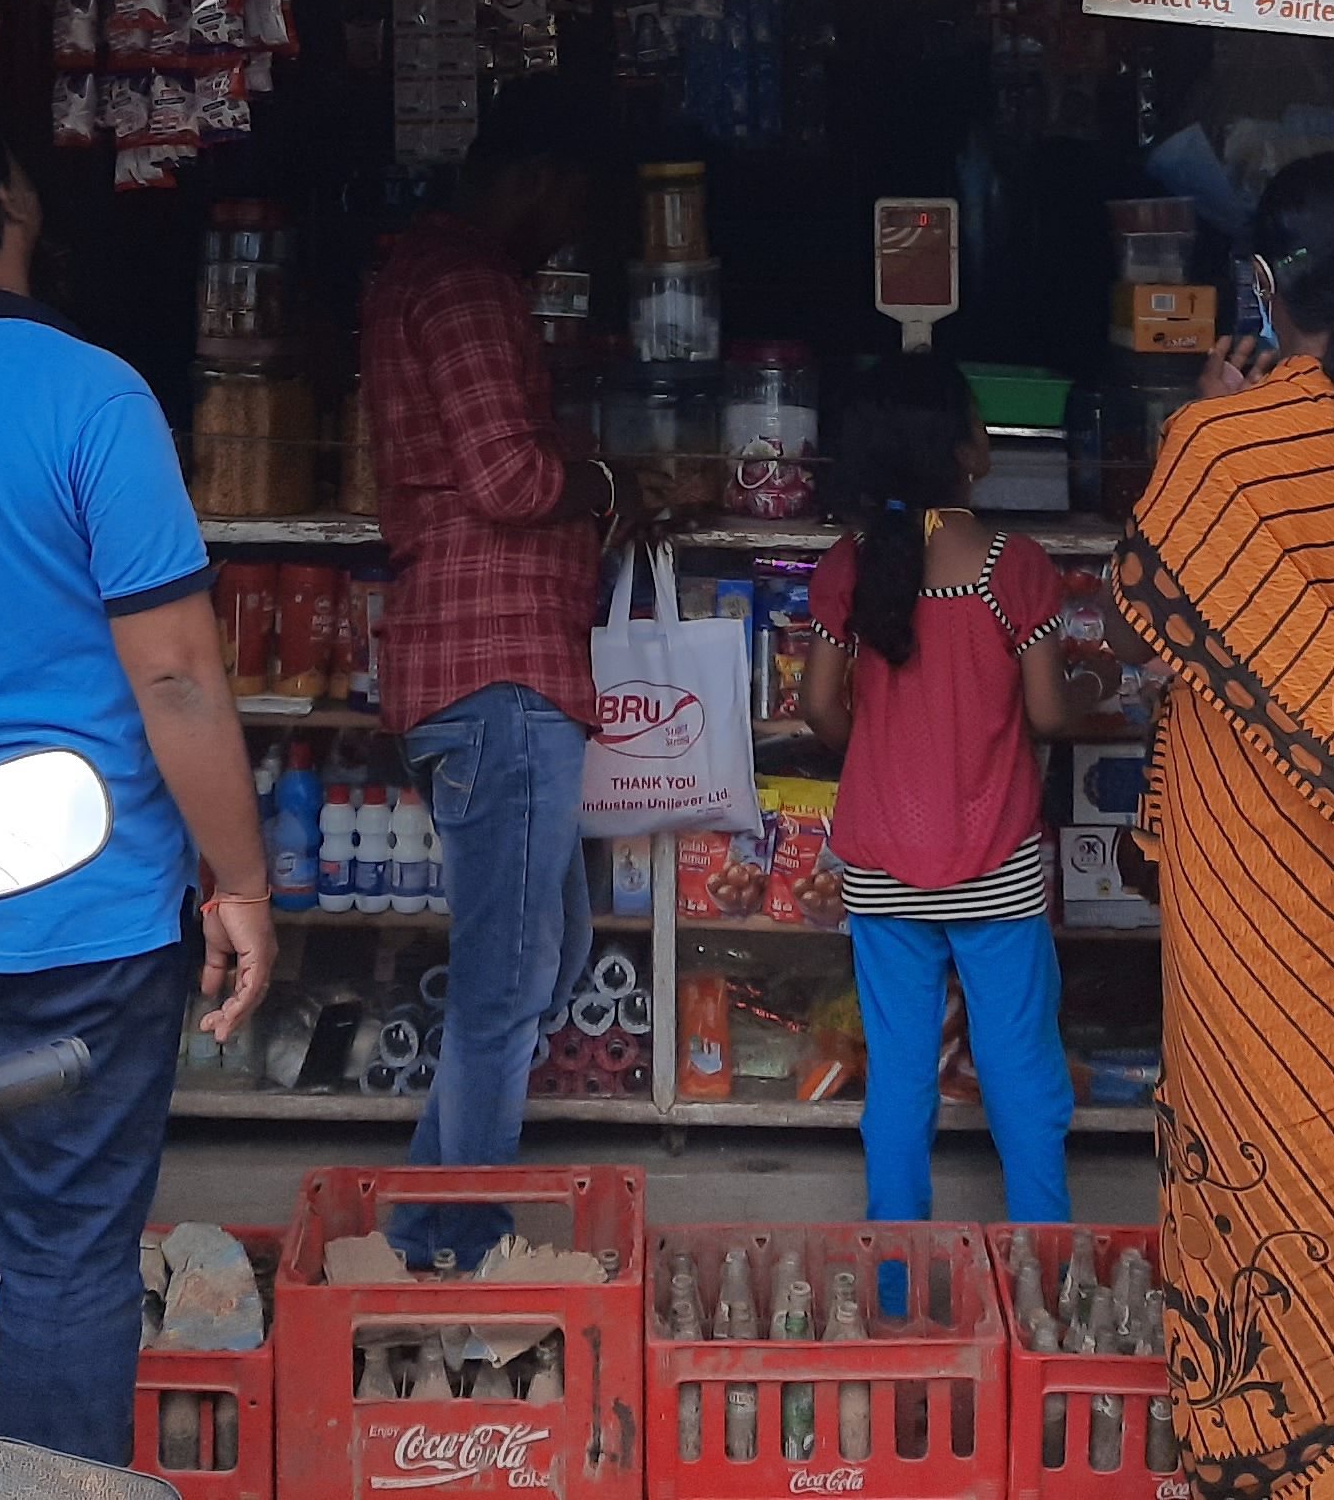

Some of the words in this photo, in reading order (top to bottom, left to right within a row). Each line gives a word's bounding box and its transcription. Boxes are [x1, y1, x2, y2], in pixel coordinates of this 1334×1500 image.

[598, 695, 661, 724] BRU
[610, 776, 662, 792] THANK
[666, 775, 696, 789] YOU
[395, 1425, 549, 1470] Coca-Cola
[509, 1468, 548, 1487] Coke
[789, 1468, 863, 1493] Coca-Cola
